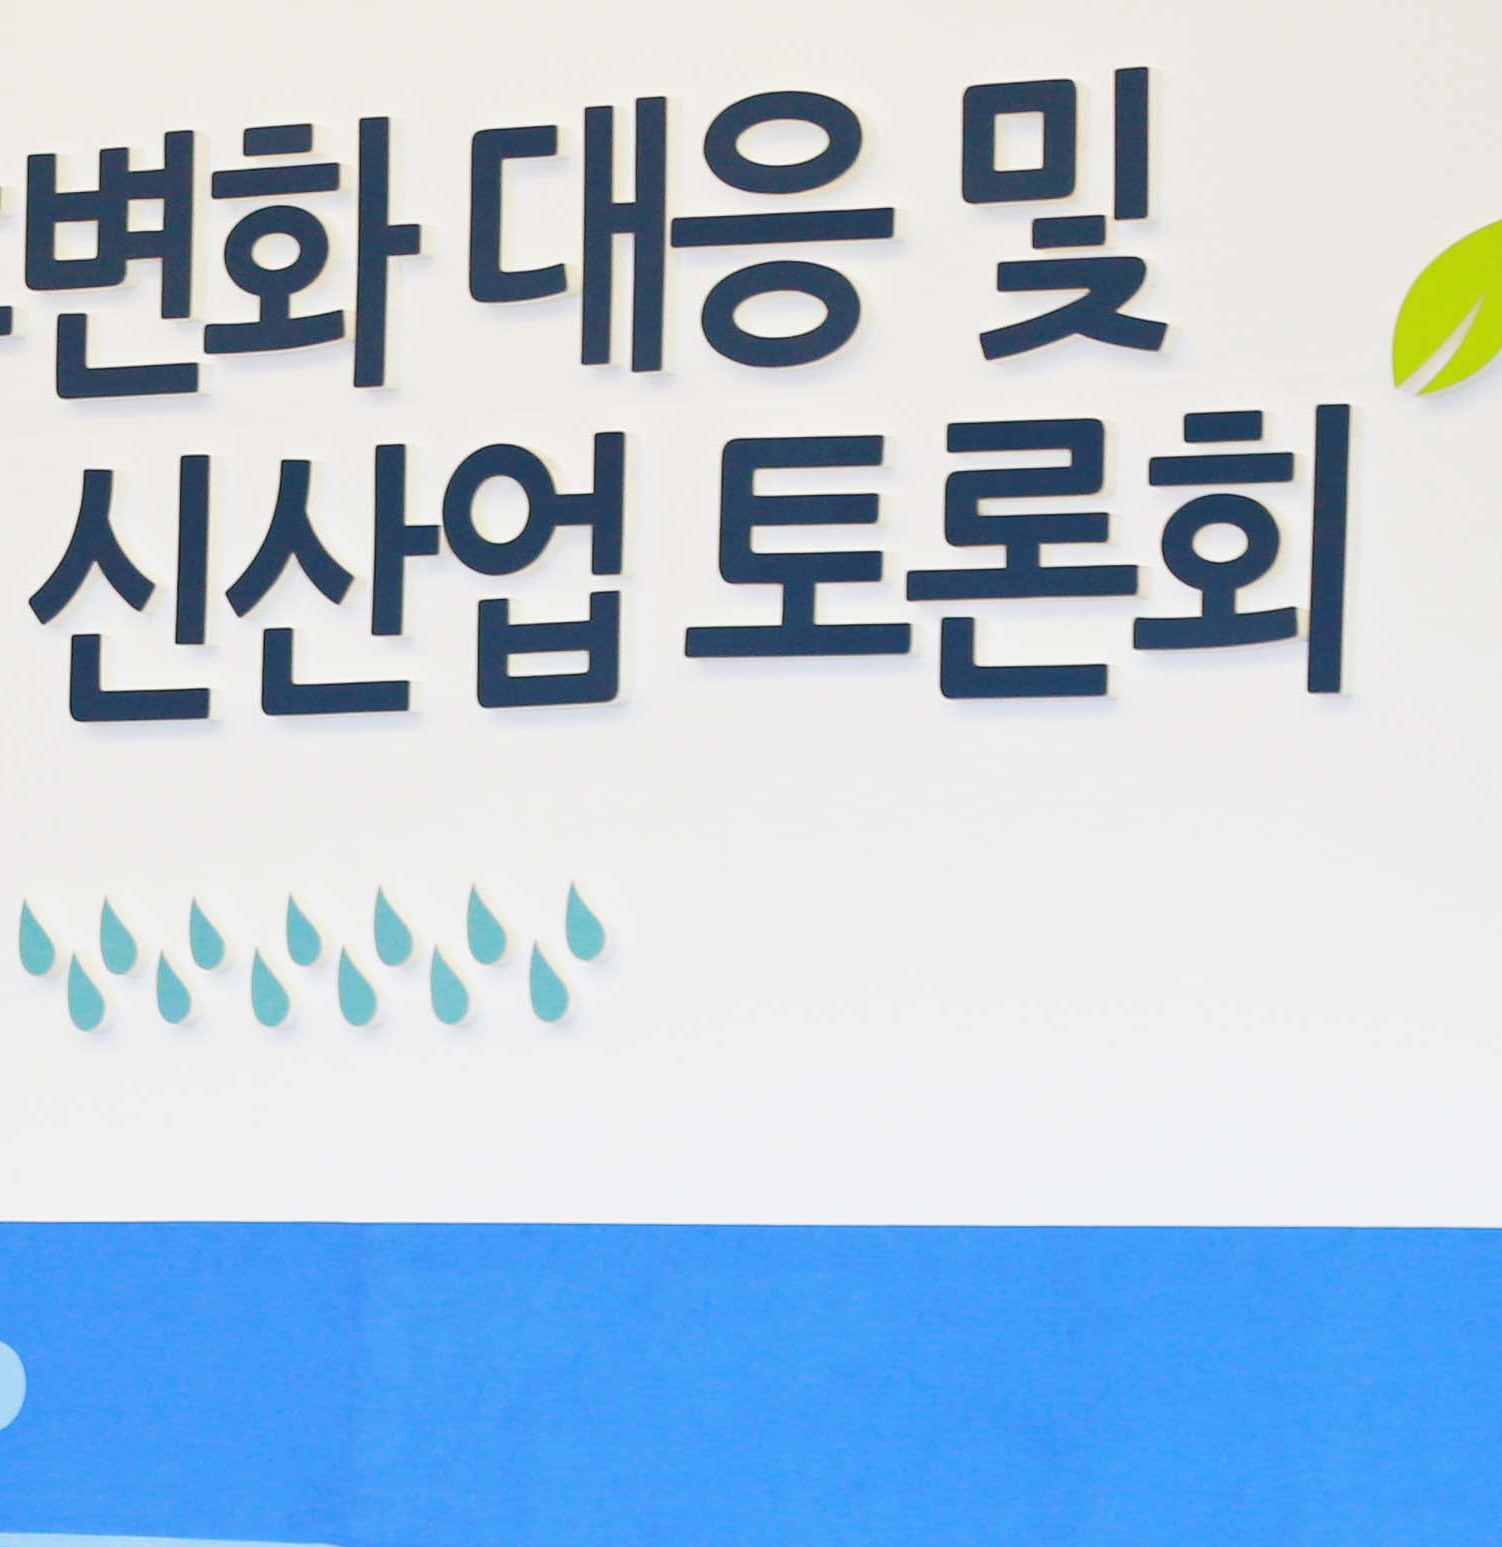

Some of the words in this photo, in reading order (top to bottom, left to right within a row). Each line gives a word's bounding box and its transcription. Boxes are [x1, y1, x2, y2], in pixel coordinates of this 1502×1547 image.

[469, 91, 894, 372] 대응
[962, 67, 1167, 360] 및
[29, 432, 625, 722] 신산업
[685, 404, 1350, 699] 토론회
